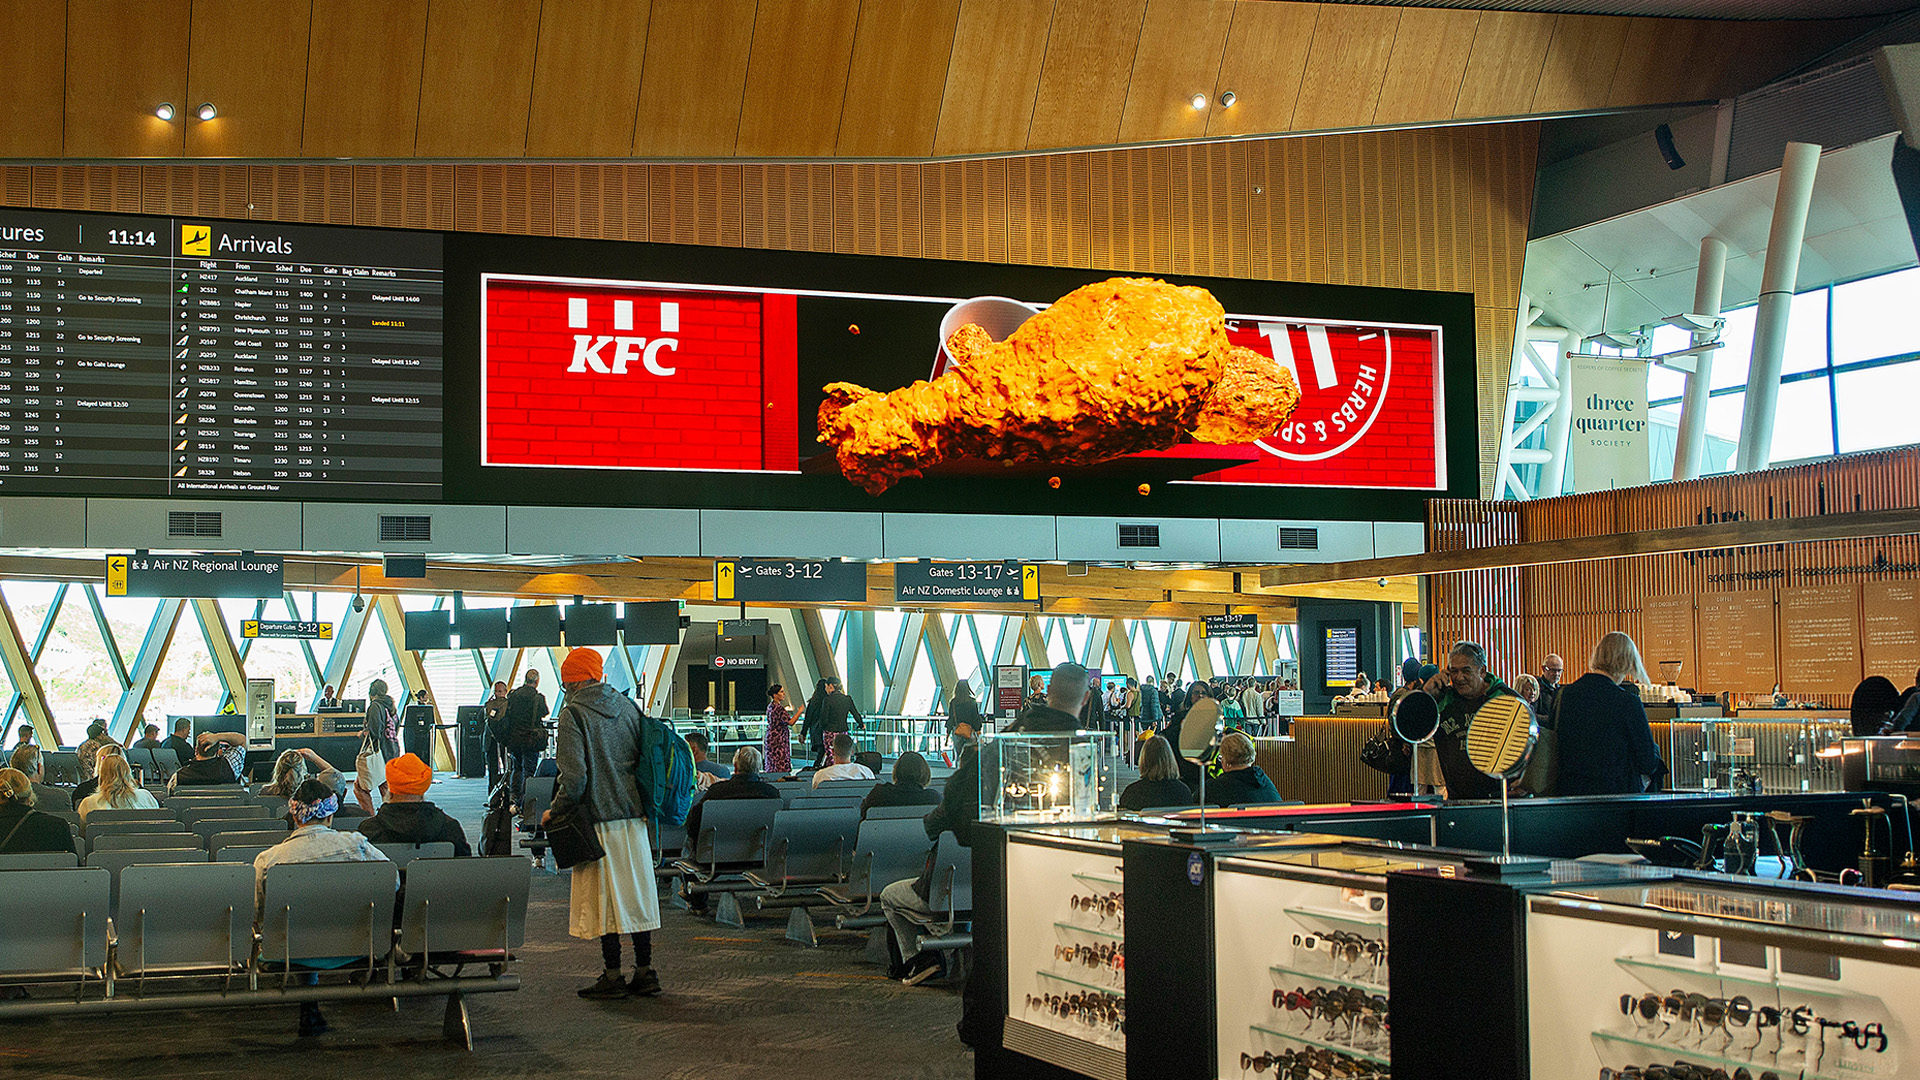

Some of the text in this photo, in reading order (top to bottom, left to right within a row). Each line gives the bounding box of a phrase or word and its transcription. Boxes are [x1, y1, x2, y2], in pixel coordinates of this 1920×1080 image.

[109, 230, 156, 245] 11:14
[219, 234, 292, 254] Arrivals
[26, 252, 40, 260] Due
[58, 254, 72, 262] Gate
[78, 254, 106, 262] Remarks
[567, 335, 678, 376] KFC
[1331, 364, 1377, 432] HERBS
[1587, 394, 1633, 411] three
[1312, 420, 1328, 442] &
[1577, 418, 1645, 433] quarter
[153, 560, 278, 573] Air NZ Regional Lounge
[756, 563, 822, 578] Gates 3-12
[930, 565, 1002, 579] Gates 13-17
[902, 586, 1002, 597] Air NZ Domestic Lounge
[298, 623, 317, 632] 5-12
